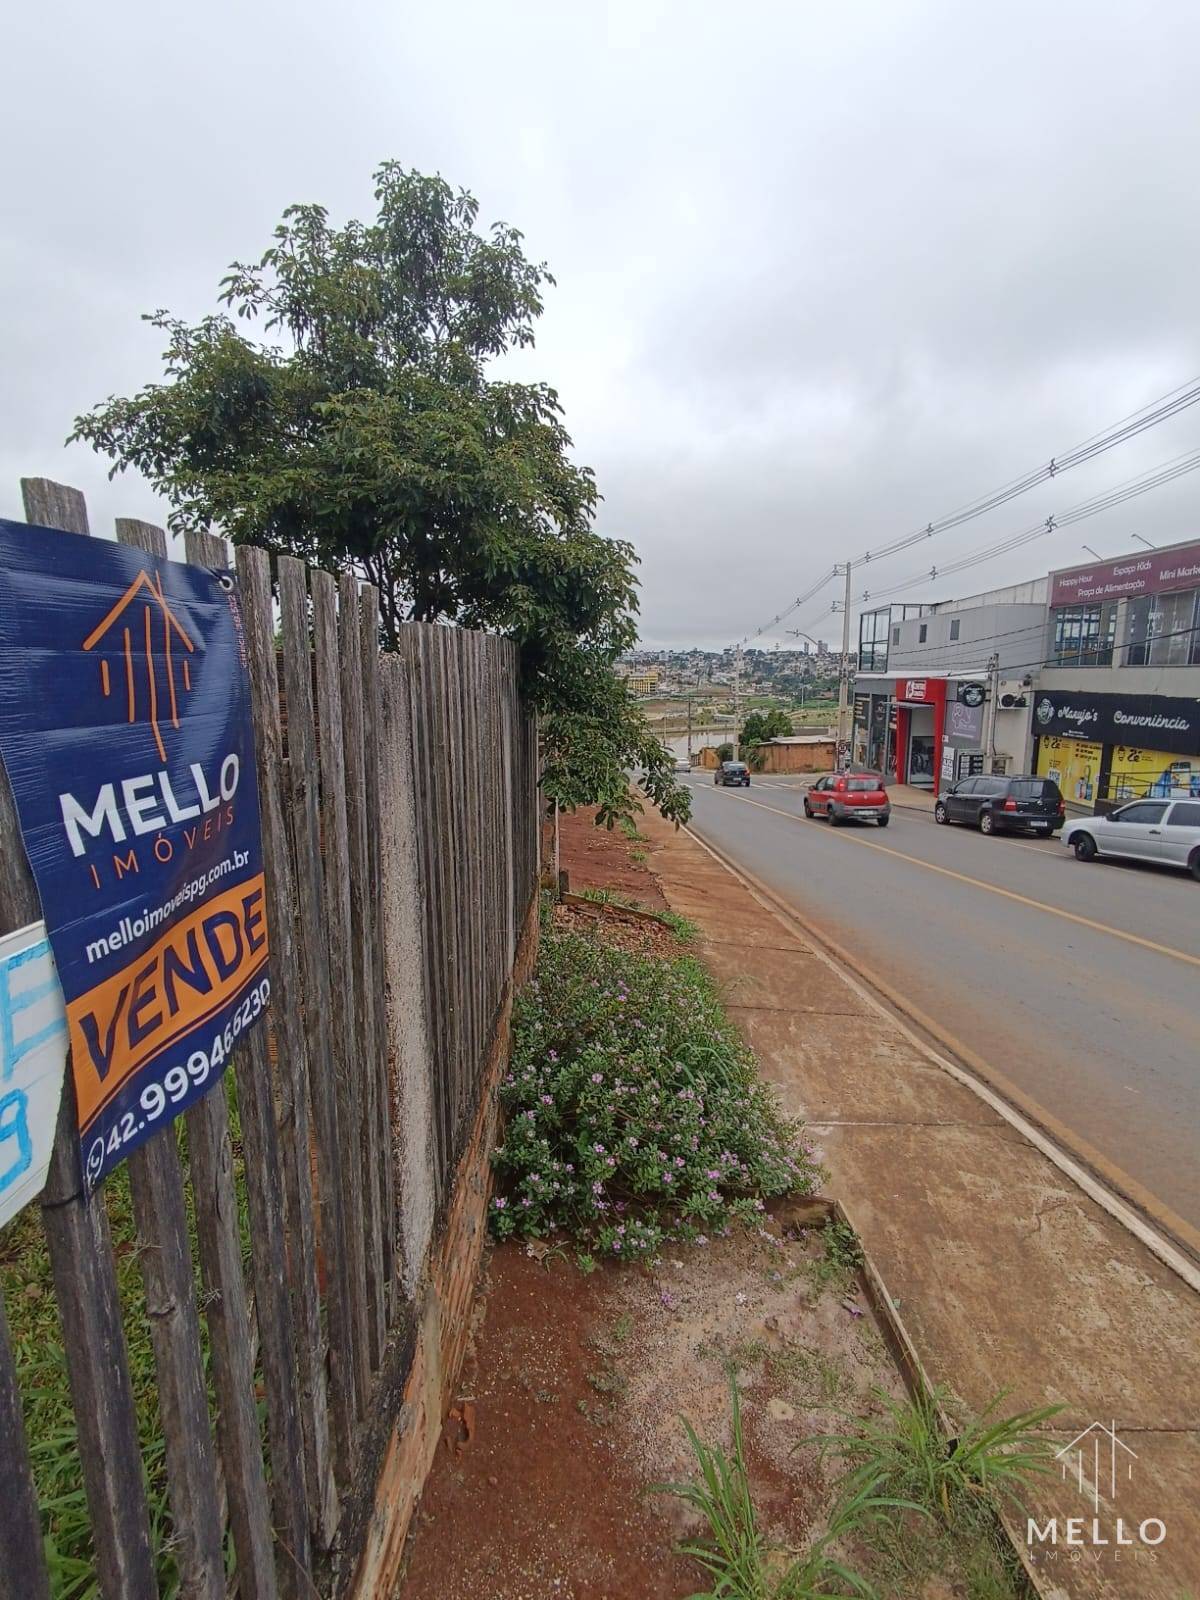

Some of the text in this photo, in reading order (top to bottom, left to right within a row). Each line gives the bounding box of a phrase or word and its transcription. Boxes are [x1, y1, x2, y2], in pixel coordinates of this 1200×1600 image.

[1059, 575, 1093, 588] Happy Hour
[1095, 584, 1103, 594] de
[1137, 560, 1152, 571] Kids
[1159, 570, 1176, 580] Mini
[59, 753, 240, 858] MELLO
[90, 805, 234, 889] IMÓVEIS
[86, 850, 250, 963] melloimoveispg.com.br
[79, 887, 266, 1083] VENDE
[106, 978, 270, 1155] 42.99946.6230
